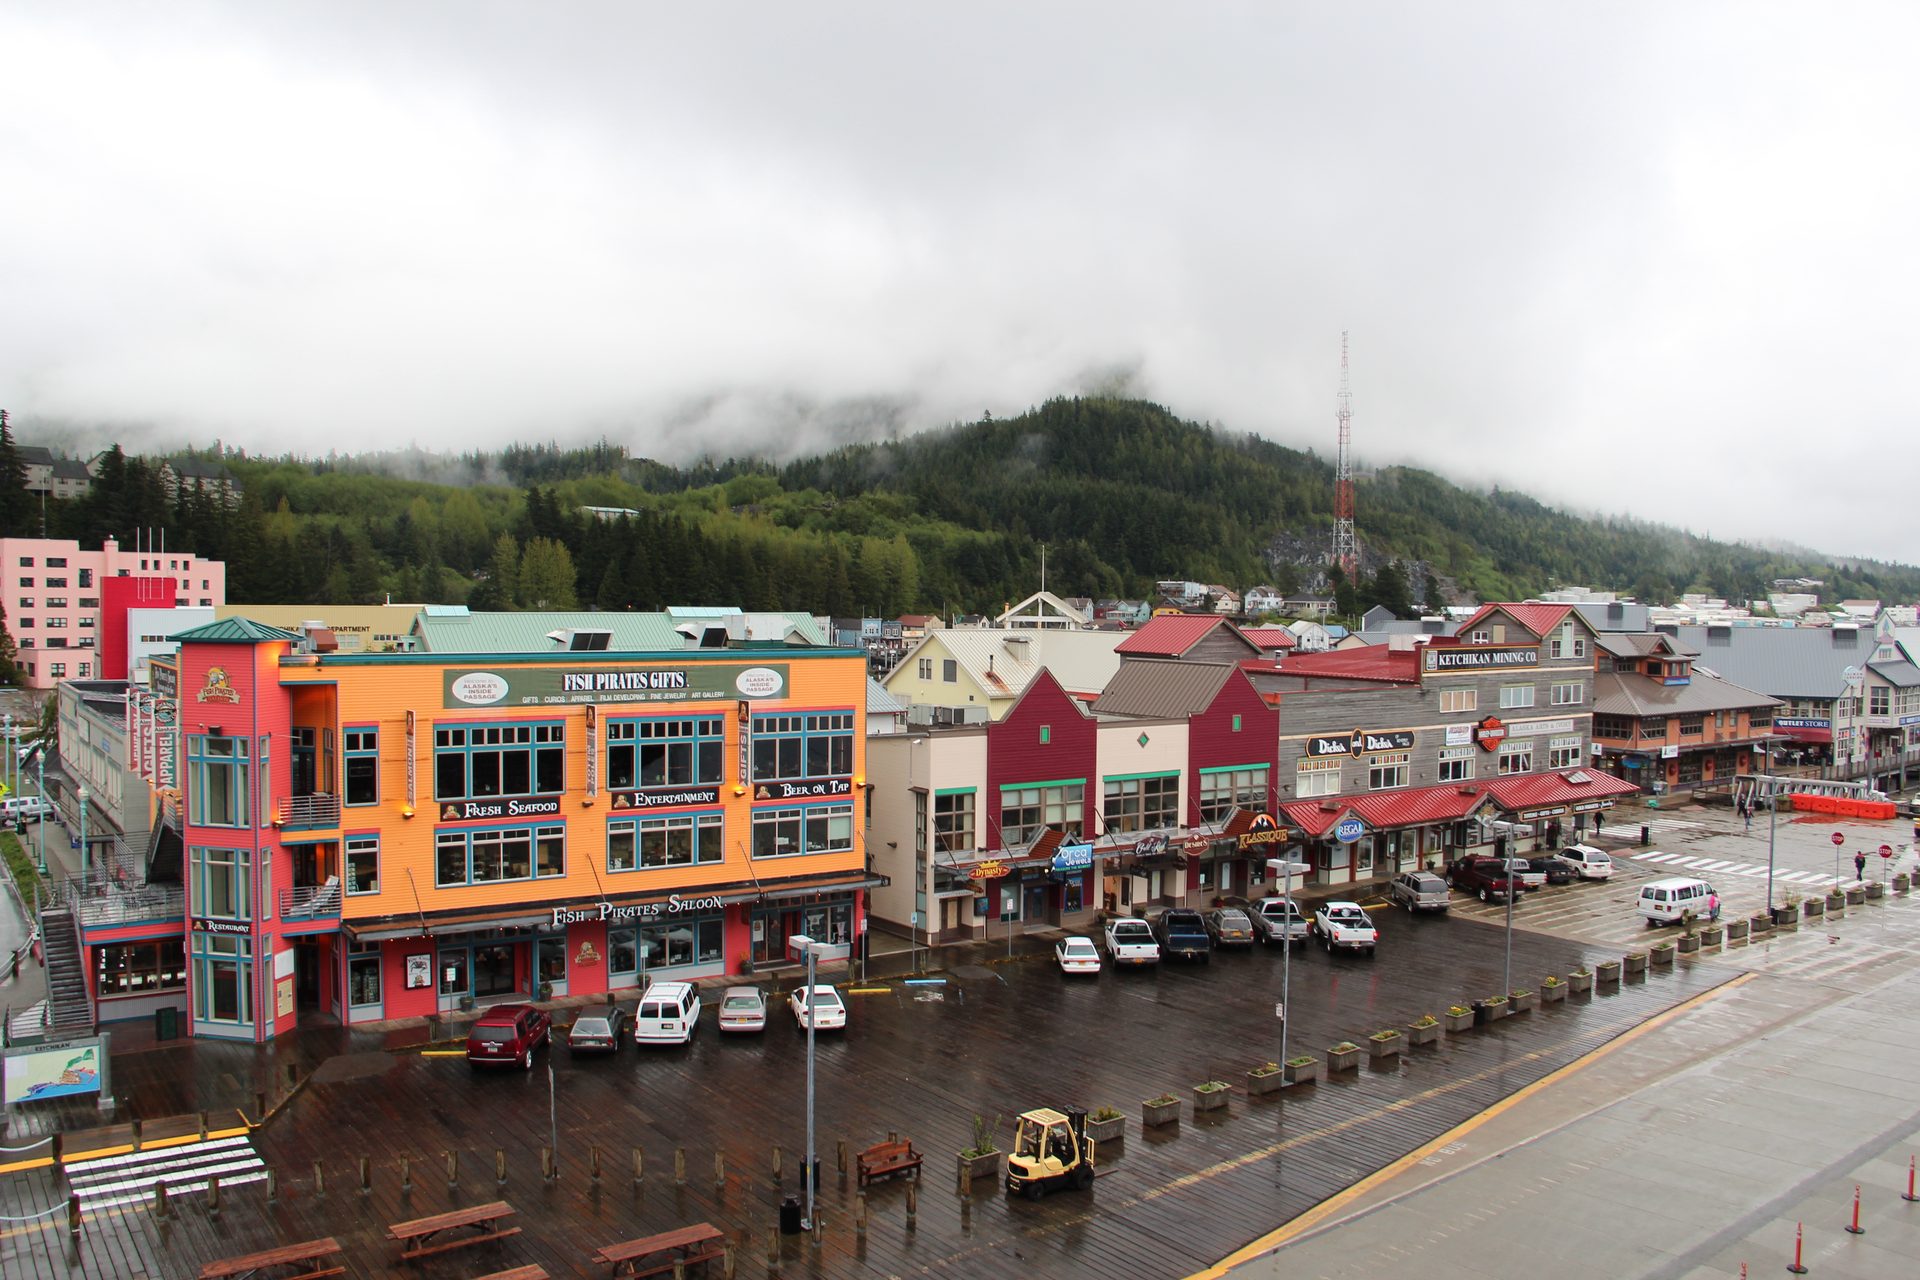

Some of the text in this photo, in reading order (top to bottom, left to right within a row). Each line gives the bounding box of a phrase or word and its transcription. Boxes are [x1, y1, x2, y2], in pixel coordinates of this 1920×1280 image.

[1439, 653, 1490, 666] KETCHIKAN
[1492, 652, 1524, 663] MINING
[564, 672, 685, 690] FISH PIRATES GIFTS
[613, 693, 646, 701] DEVELOPING
[160, 733, 173, 784] APPAREL
[780, 780, 849, 797] BEER ON TAP
[634, 791, 714, 806] ENTERTAINMENT
[464, 800, 557, 818] FRESH SEAFOOD
[1338, 822, 1362, 836] REGAL
[1239, 829, 1288, 849] KLASSIQUE
[1065, 858, 1092, 866] Jewels
[975, 867, 1003, 878] Dynasty
[552, 894, 724, 927] FISH PIRATES SALOON
[206, 920, 250, 933] RESTAURANT
[35, 1042, 70, 1052] KETCHIKAN
